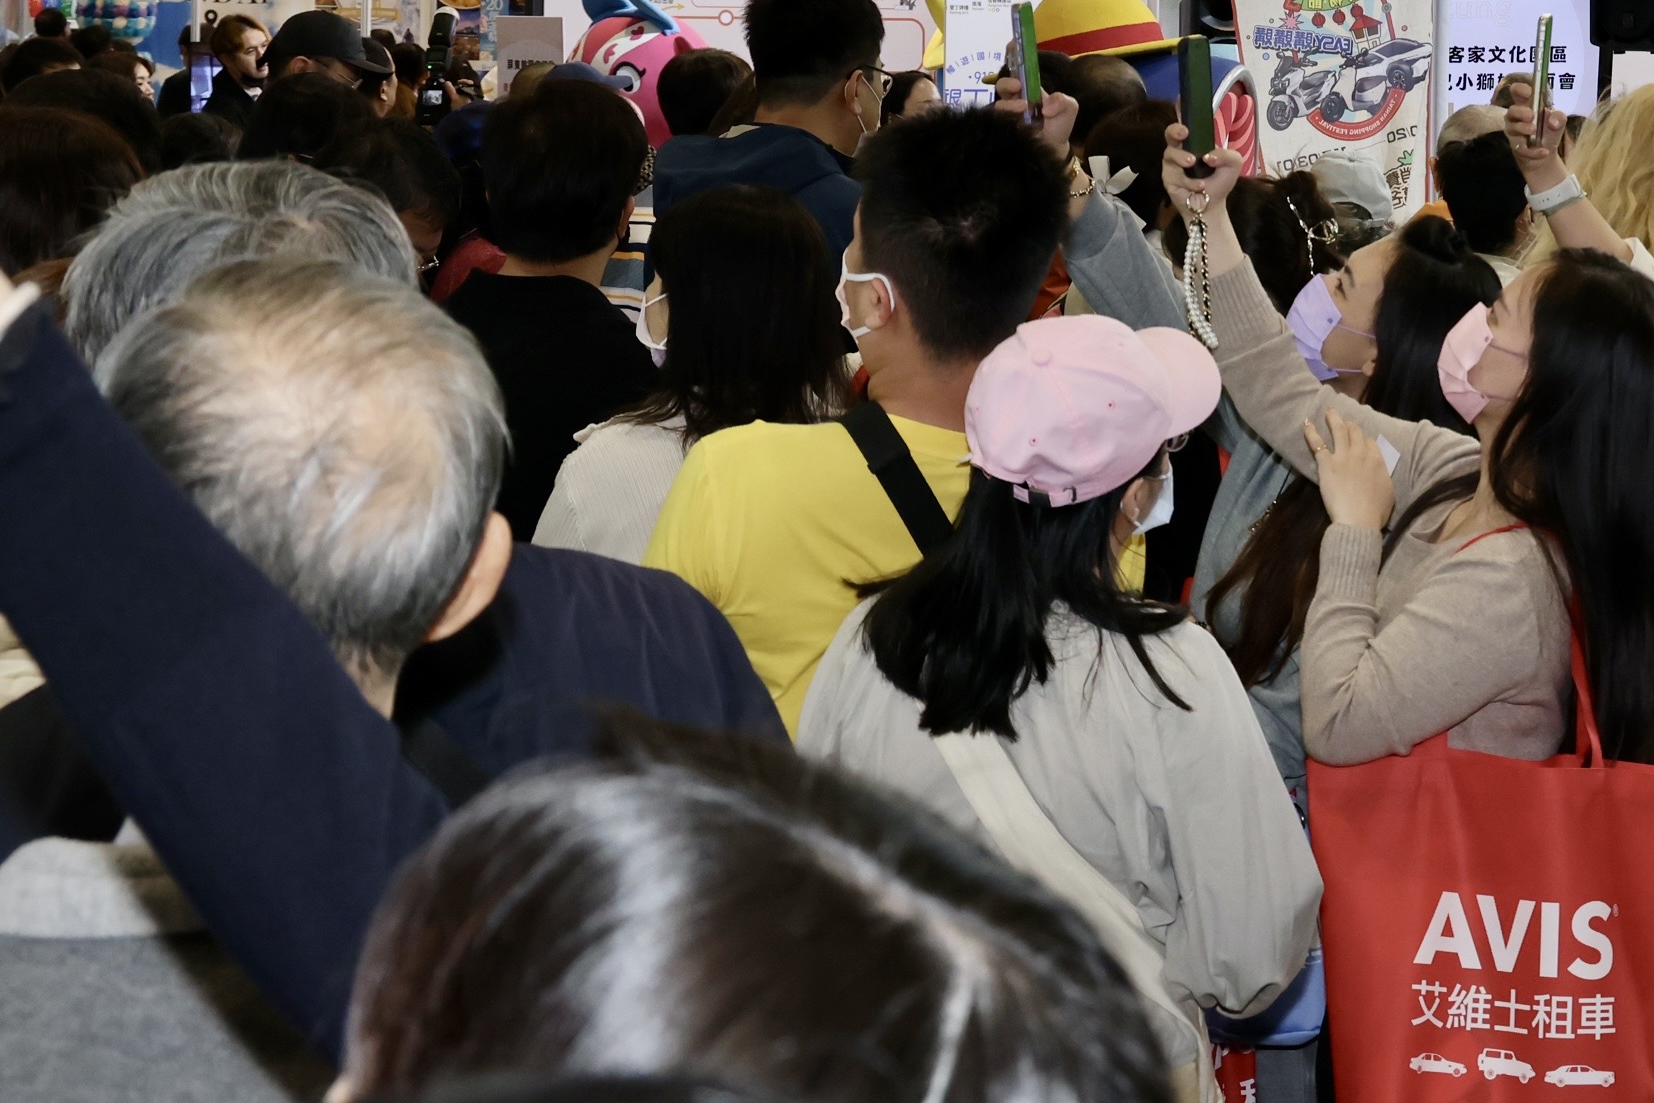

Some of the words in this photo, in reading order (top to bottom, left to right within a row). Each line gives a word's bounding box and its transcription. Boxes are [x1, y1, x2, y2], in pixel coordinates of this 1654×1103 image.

[1413, 890, 1614, 981] AVIS
[1410, 978, 1617, 1041] 艾維士租車
